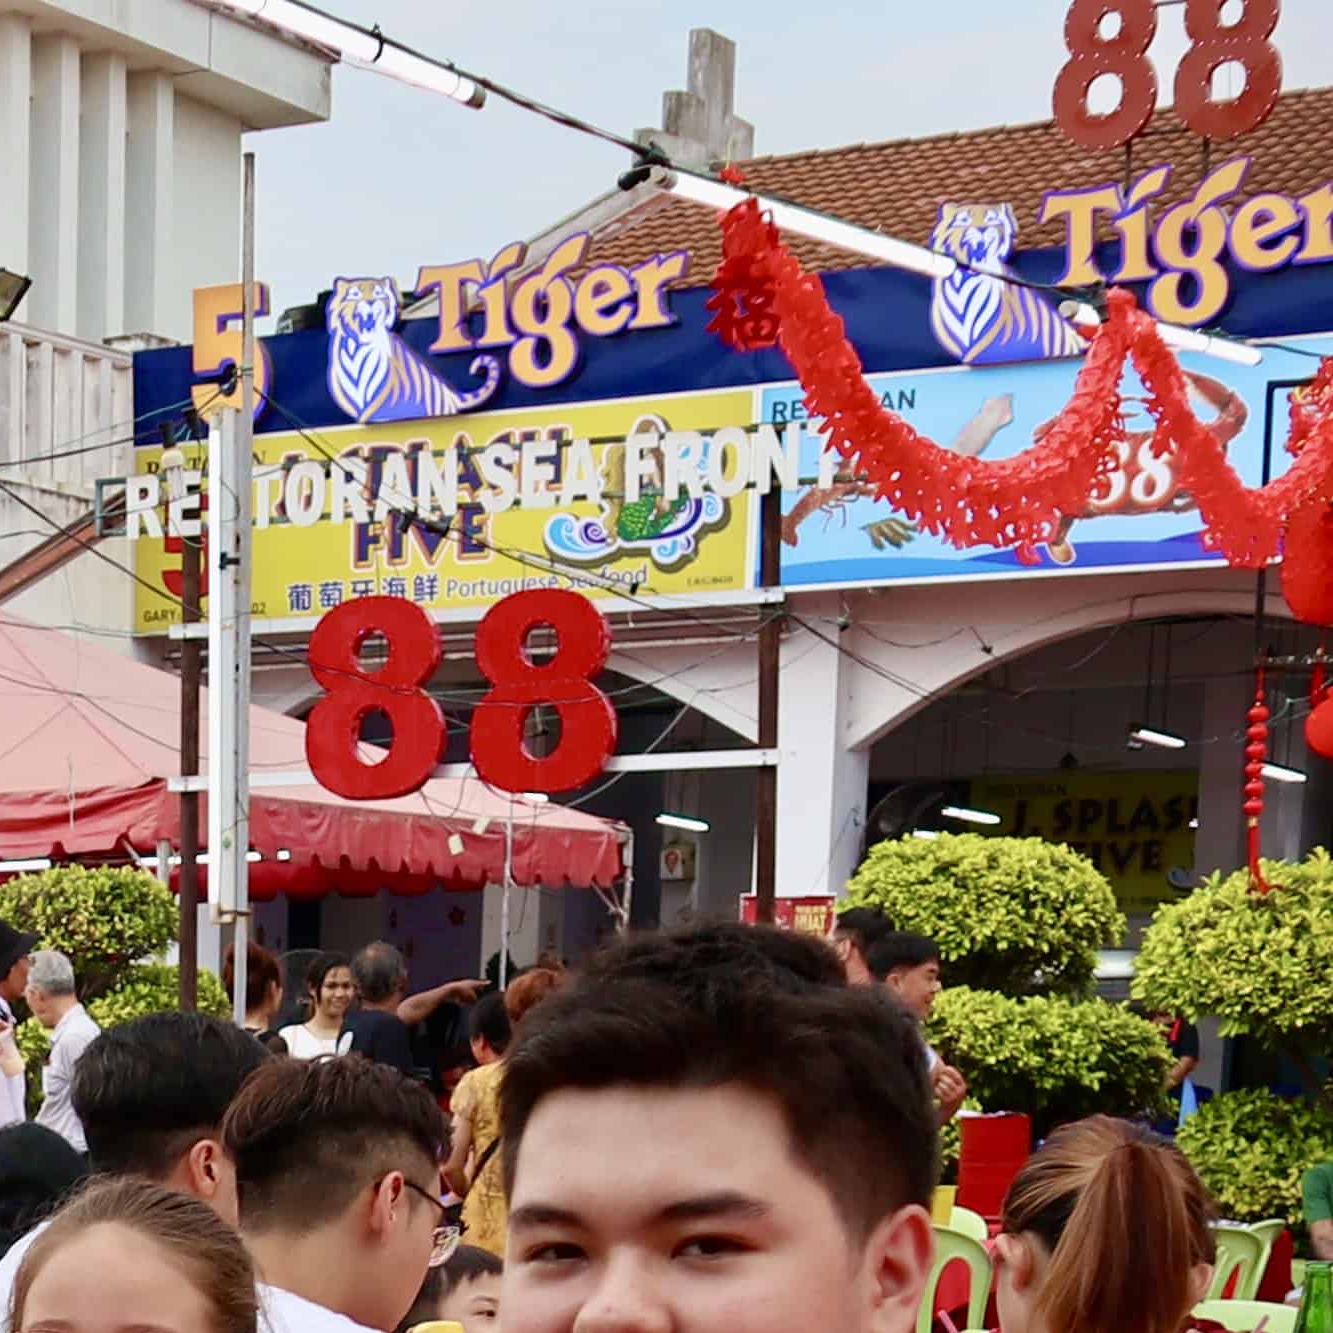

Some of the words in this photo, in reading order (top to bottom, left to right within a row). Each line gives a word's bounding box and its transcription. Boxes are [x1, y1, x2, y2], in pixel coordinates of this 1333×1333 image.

[1053, 0, 1283, 150] 88
[416, 231, 691, 389] Tiger
[1038, 156, 1333, 327] Tiger
[190, 281, 271, 424] 5
[126, 448, 458, 540] RETORAN
[480, 435, 604, 514] SEA
[143, 609, 176, 623] GARY
[446, 575, 559, 598] Portuguese
[305, 588, 619, 799] 88
[1052, 796, 1199, 833] SPLAS
